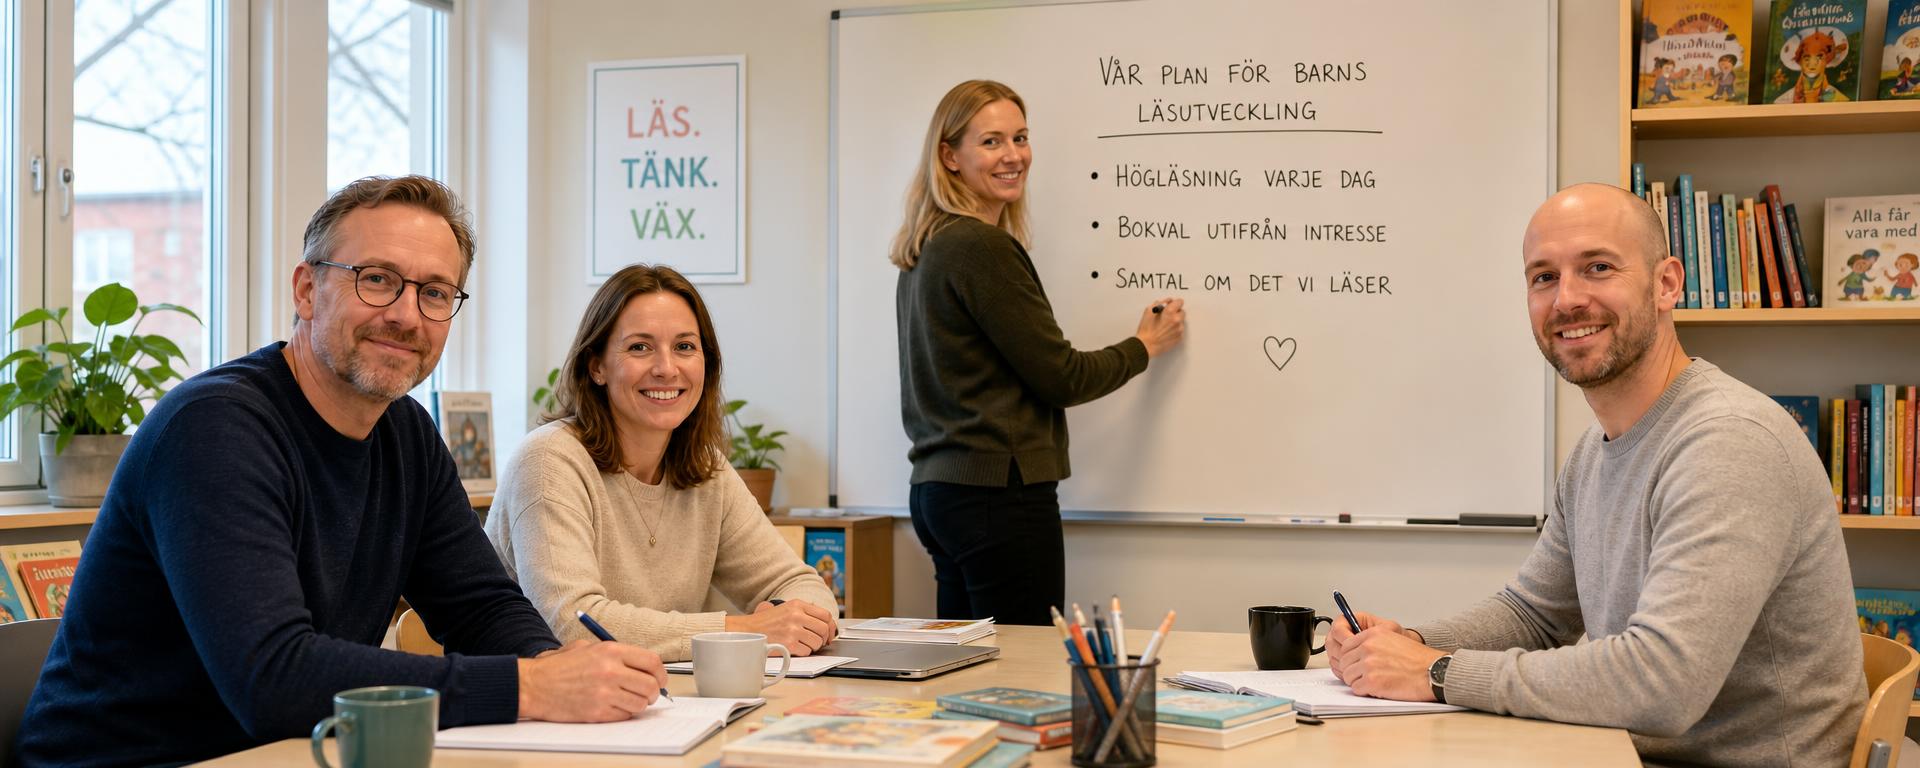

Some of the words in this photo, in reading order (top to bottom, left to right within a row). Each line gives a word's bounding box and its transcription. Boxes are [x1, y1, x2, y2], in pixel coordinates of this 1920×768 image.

[1098, 55, 1143, 86] VÅR
[1161, 64, 1208, 85] PLAN
[1228, 58, 1271, 84] FÖR
[1294, 61, 1367, 84] BARNS
[627, 99, 701, 139] LÄS.
[1138, 98, 1317, 123] LÄSUTVECKLING
[620, 150, 718, 189] TÄNK.
[1116, 163, 1242, 188] HÖGLÄSNING
[1264, 169, 1323, 189] VARJE
[1340, 169, 1376, 189] DAG
[630, 201, 705, 240] VÄX.
[1117, 215, 1192, 240] BOKVAL
[1207, 217, 1287, 241] UTIFRÅN
[1304, 223, 1387, 243] INTRESSE
[1852, 208, 1882, 223] Alla
[1888, 207, 1911, 221] får
[1845, 227, 1879, 240] vara
[1885, 222, 1918, 238] med
[1115, 267, 1190, 291] SAMTAL
[1204, 274, 1232, 292] OM
[1249, 274, 1284, 293] DET
[1298, 275, 1314, 293] VI
[1329, 270, 1393, 296] LÄSER
